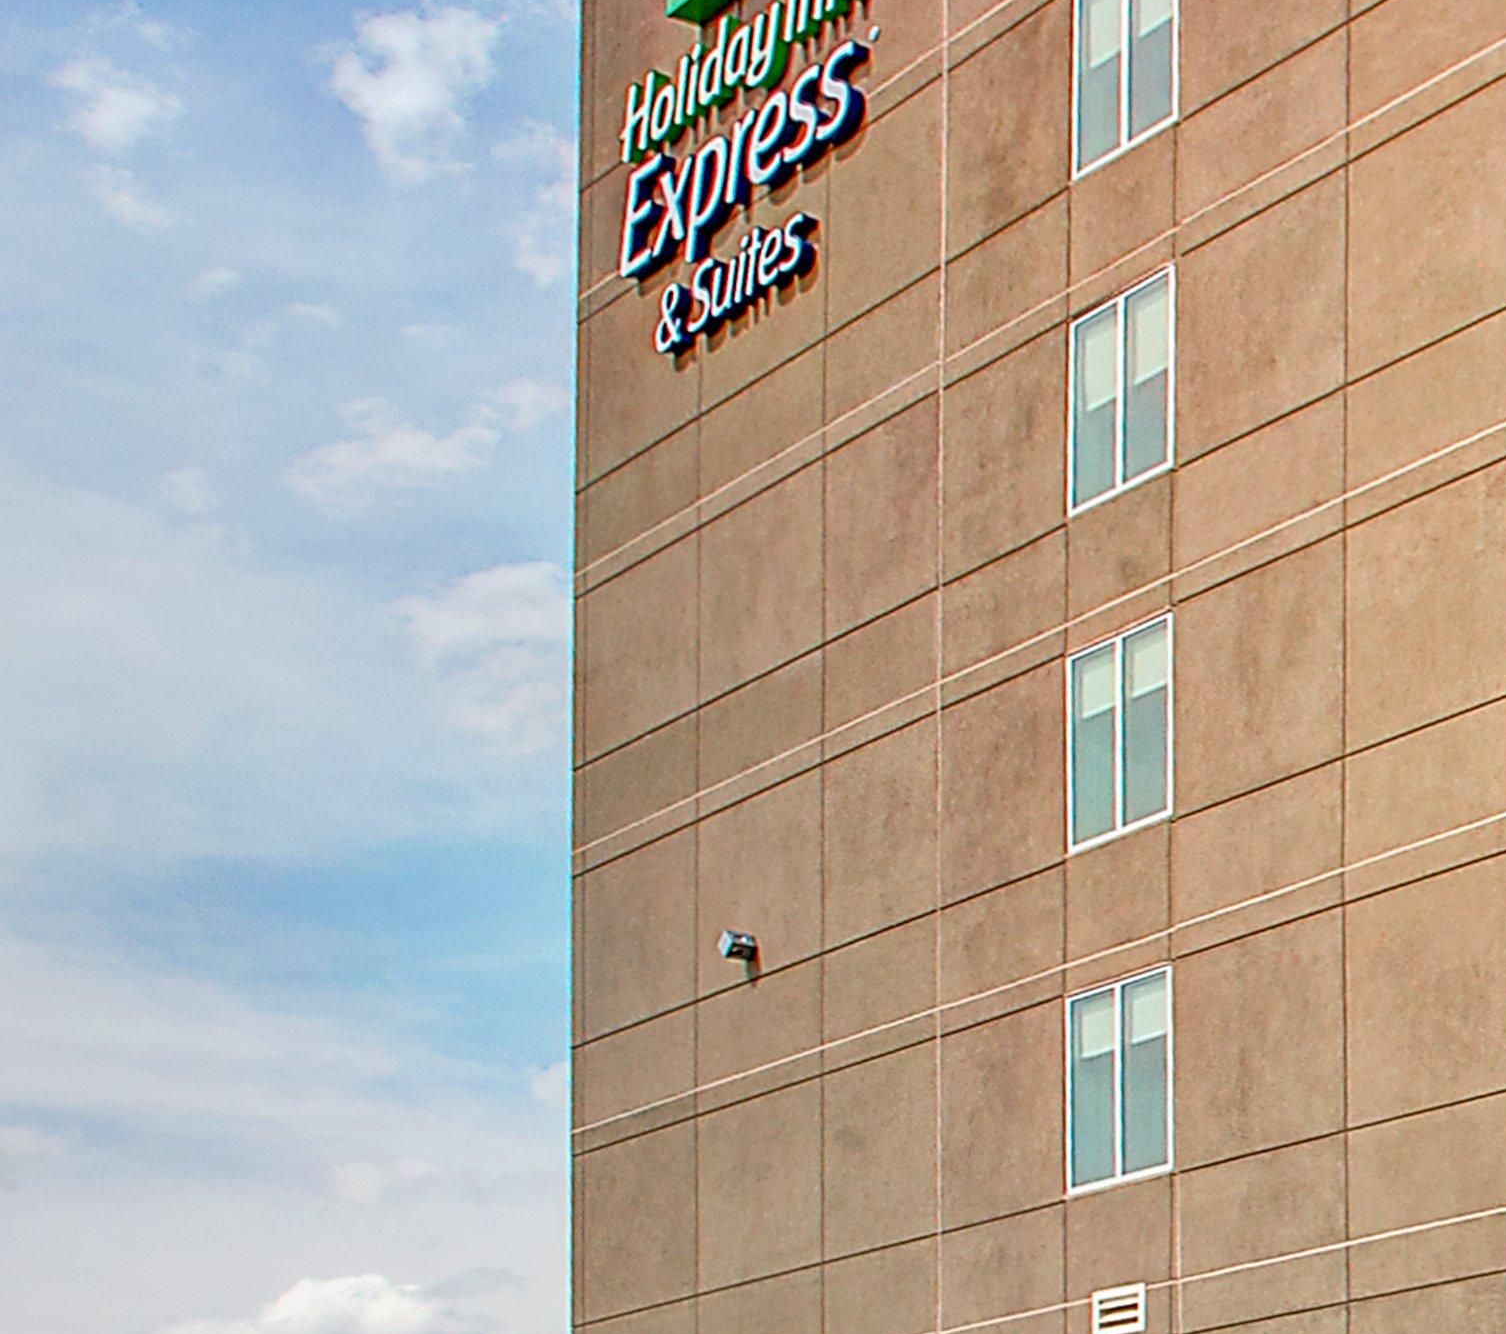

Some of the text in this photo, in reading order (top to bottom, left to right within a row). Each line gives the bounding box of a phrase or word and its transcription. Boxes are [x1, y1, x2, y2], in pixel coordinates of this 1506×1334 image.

[618, 40, 858, 278] Express
[621, 2, 783, 164] Holiday
[654, 212, 805, 354] & Suites
